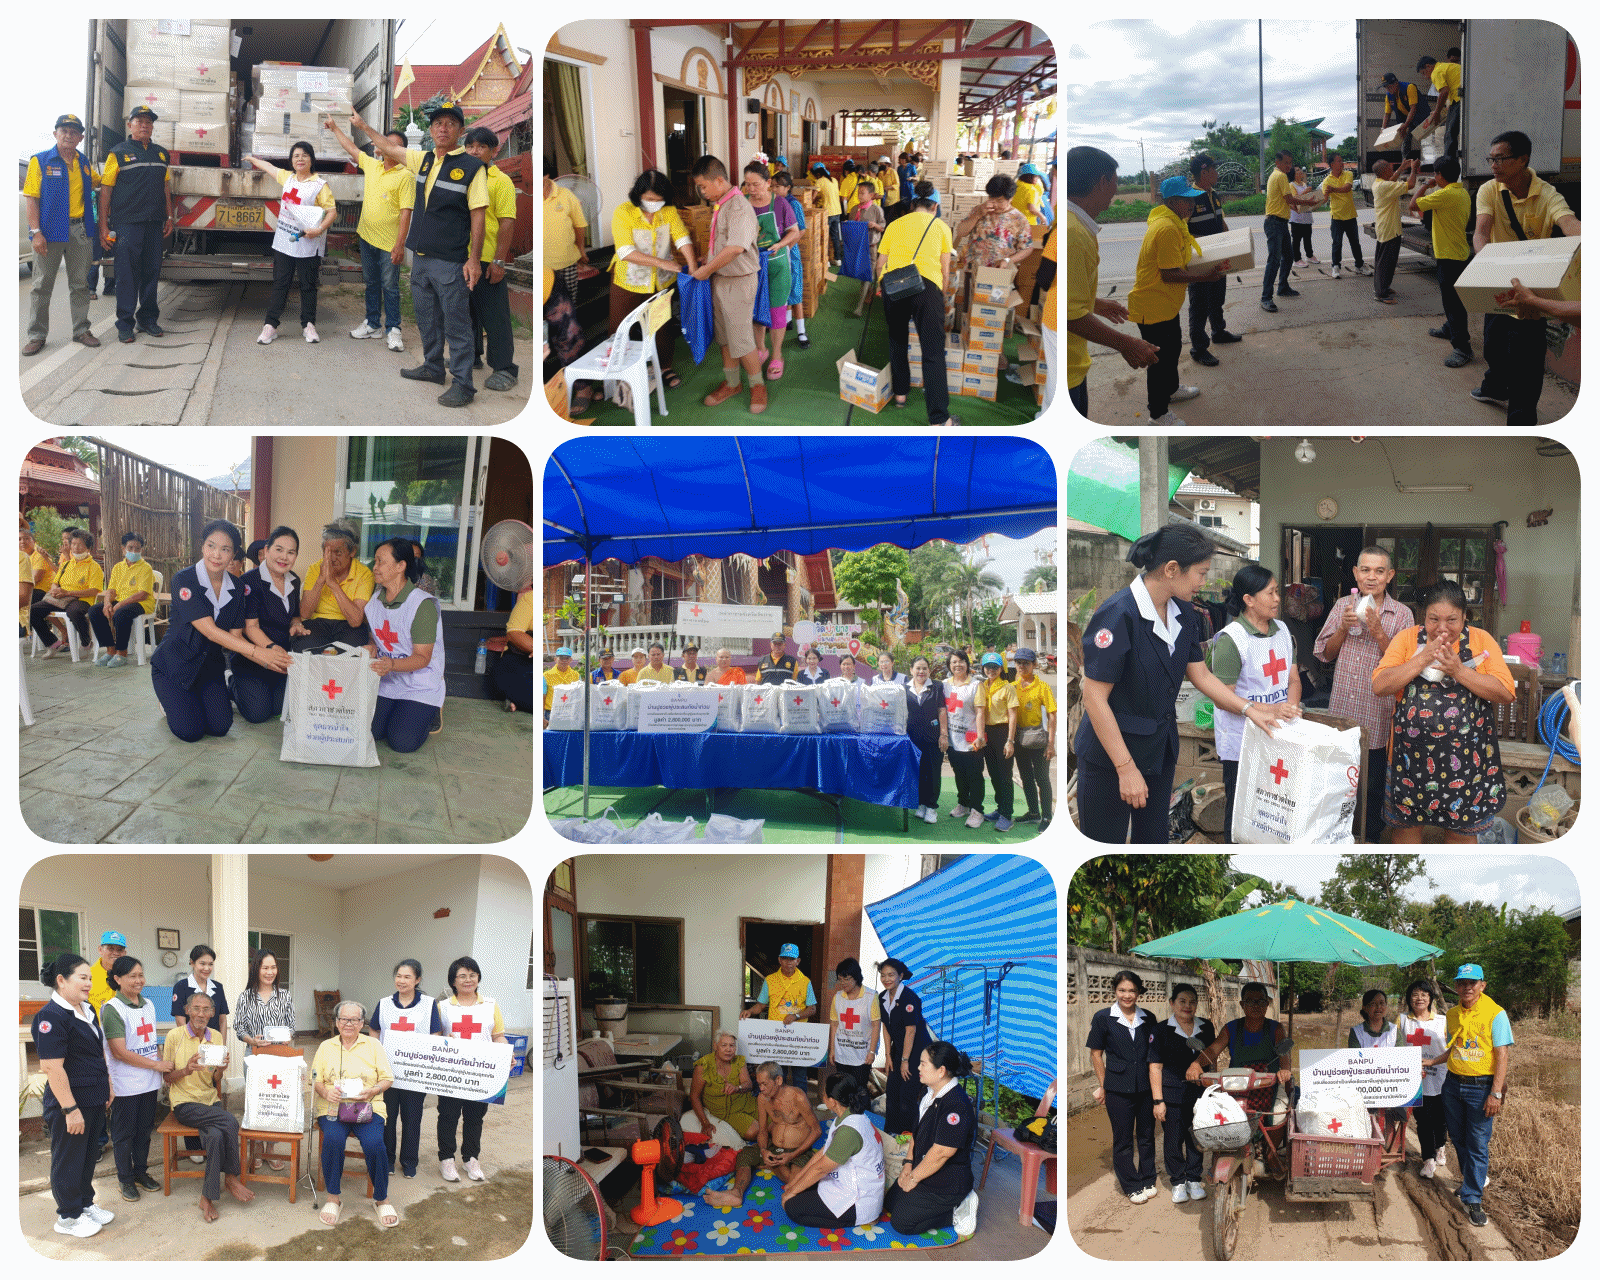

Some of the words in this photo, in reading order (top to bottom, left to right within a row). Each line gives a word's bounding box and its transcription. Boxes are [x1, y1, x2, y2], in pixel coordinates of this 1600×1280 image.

[219, 210, 261, 222] 71-8667
[1256, 787, 1296, 808] สภากาชาดไทย
[432, 1045, 459, 1054] BANPU
[394, 1049, 496, 1070] บ้านปูช่วยผู้ประสบภัยน้ำท่วม
[404, 1069, 423, 1078] มูลค่า
[425, 1072, 462, 1084] 2,800,000
[464, 1078, 480, 1086] บาท
[1312, 1065, 1410, 1077] บ้านปูช่วยผู้ประสบภัยน้ำท่วม
